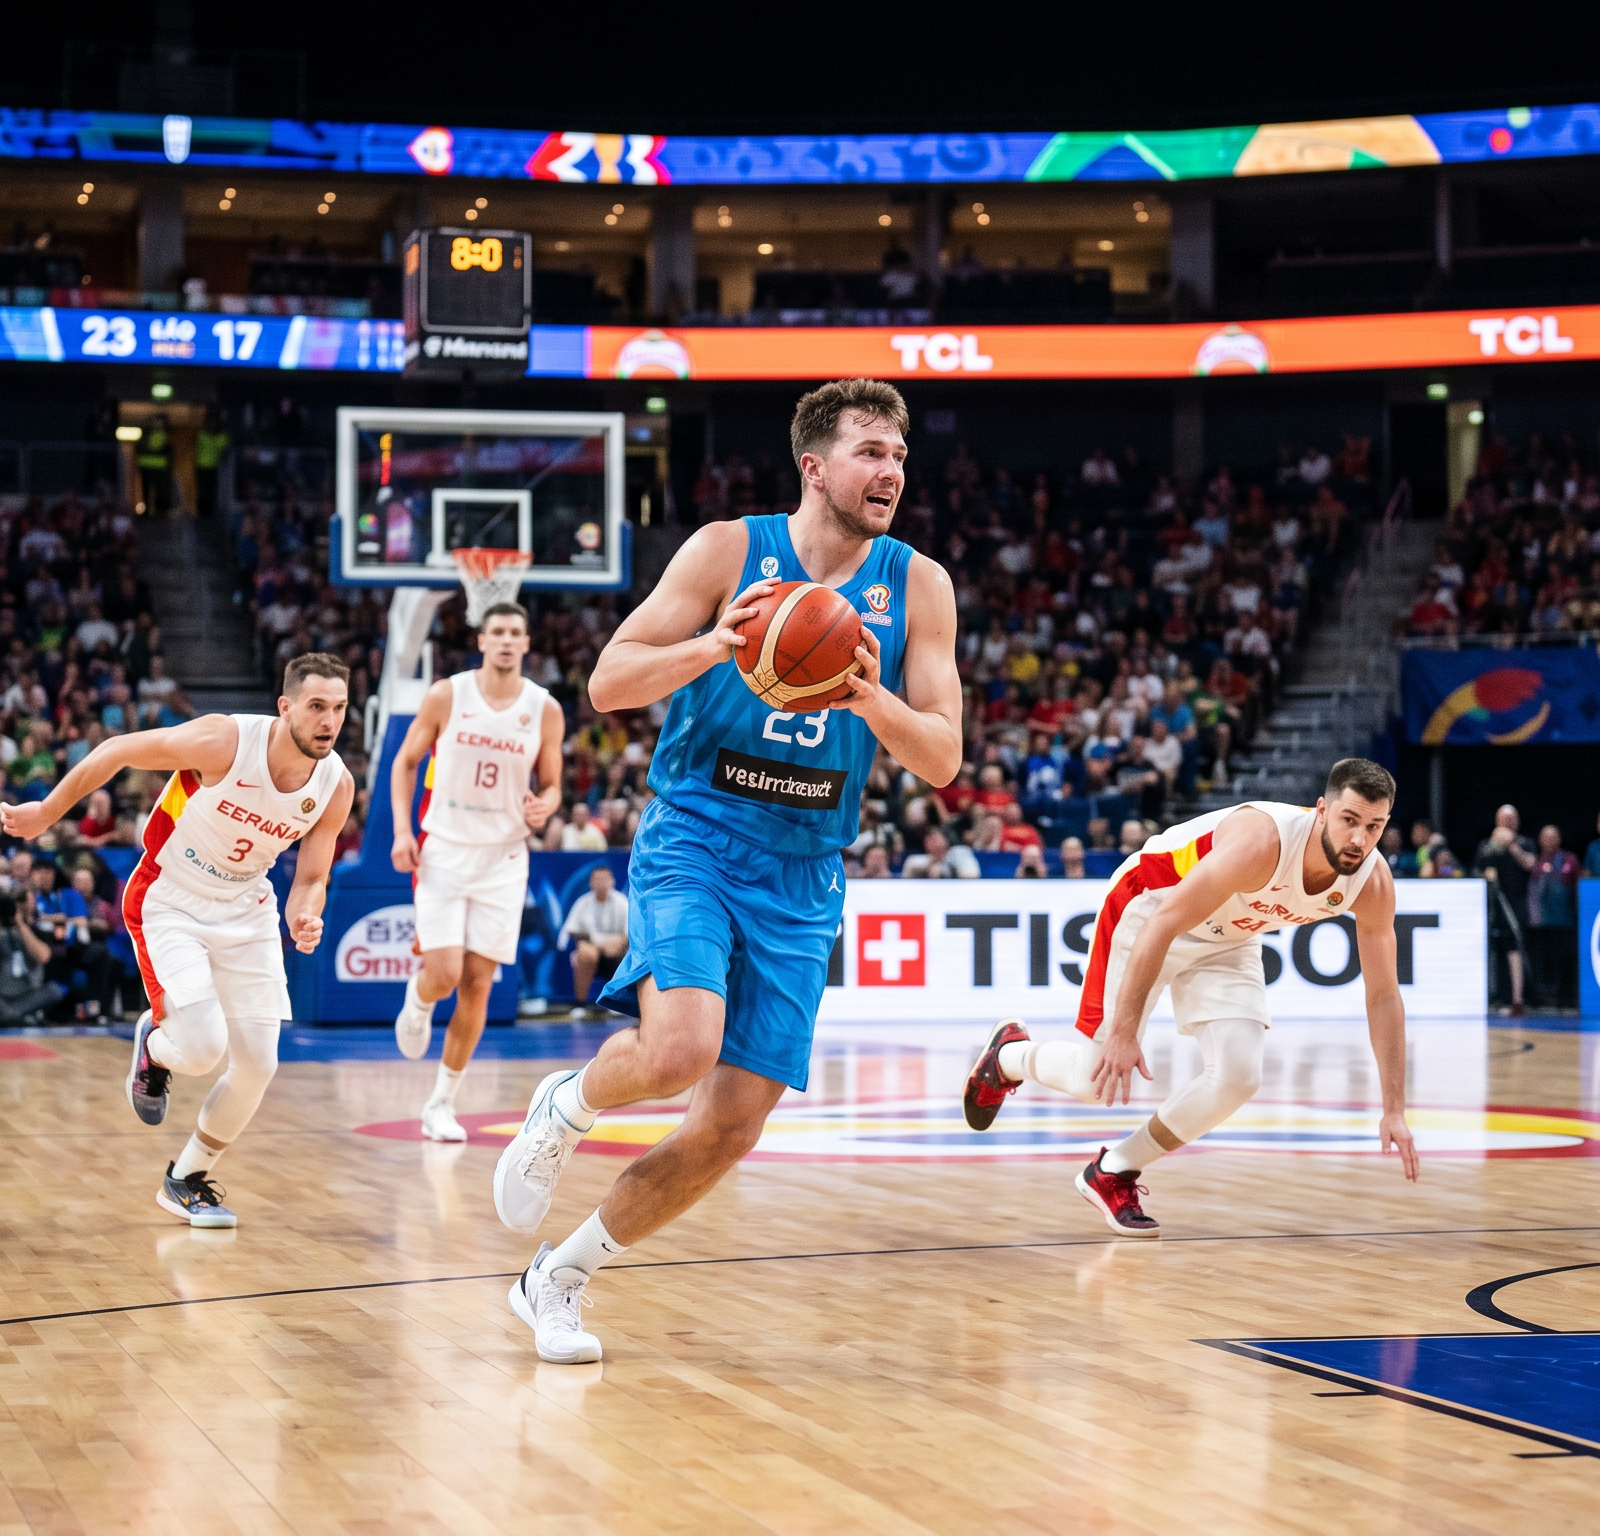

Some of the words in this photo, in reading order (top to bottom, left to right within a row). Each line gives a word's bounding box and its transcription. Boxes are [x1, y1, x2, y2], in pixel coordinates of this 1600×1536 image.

[81, 315, 137, 357] 23
[212, 320, 263, 361] 17
[890, 333, 993, 372] TCL
[1468, 316, 1574, 356] TCL
[762, 708, 830, 748] 23
[474, 760, 499, 790] 13
[227, 838, 254, 863] 3
